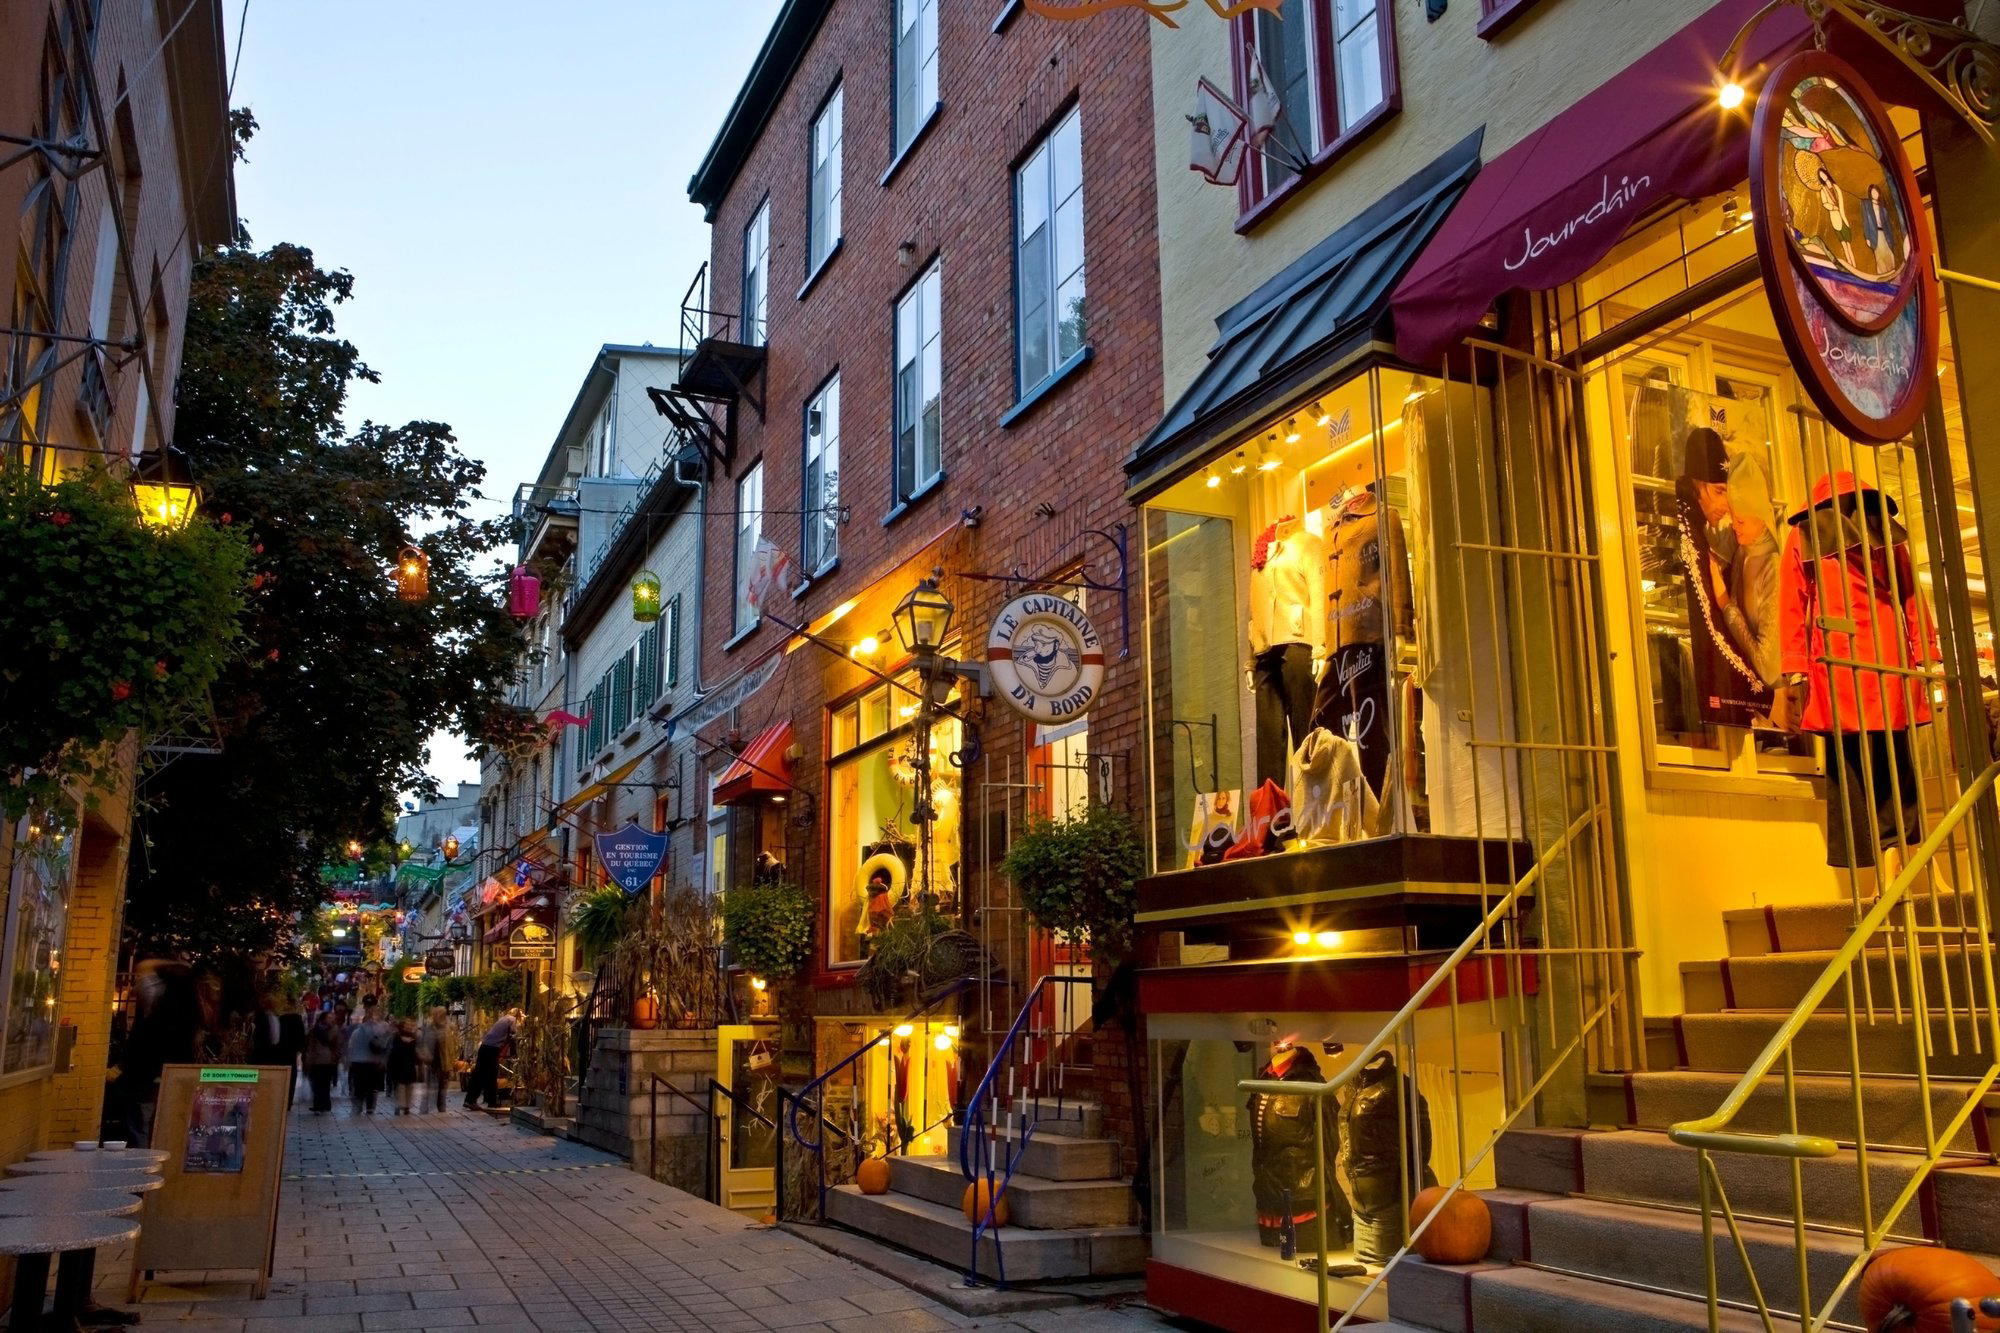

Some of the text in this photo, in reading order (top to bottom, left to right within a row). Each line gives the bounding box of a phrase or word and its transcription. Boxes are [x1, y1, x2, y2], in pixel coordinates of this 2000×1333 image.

[1504, 174, 1650, 270] Jourdain
[1820, 327, 1909, 379] Jourdain
[997, 597, 1099, 649] LE CAPITAINE
[1011, 684, 1093, 716] D'A BORD
[1181, 784, 1349, 851] Jourdain
[620, 852, 658, 860] TOURISME
[623, 859, 654, 868] QUÉBEC
